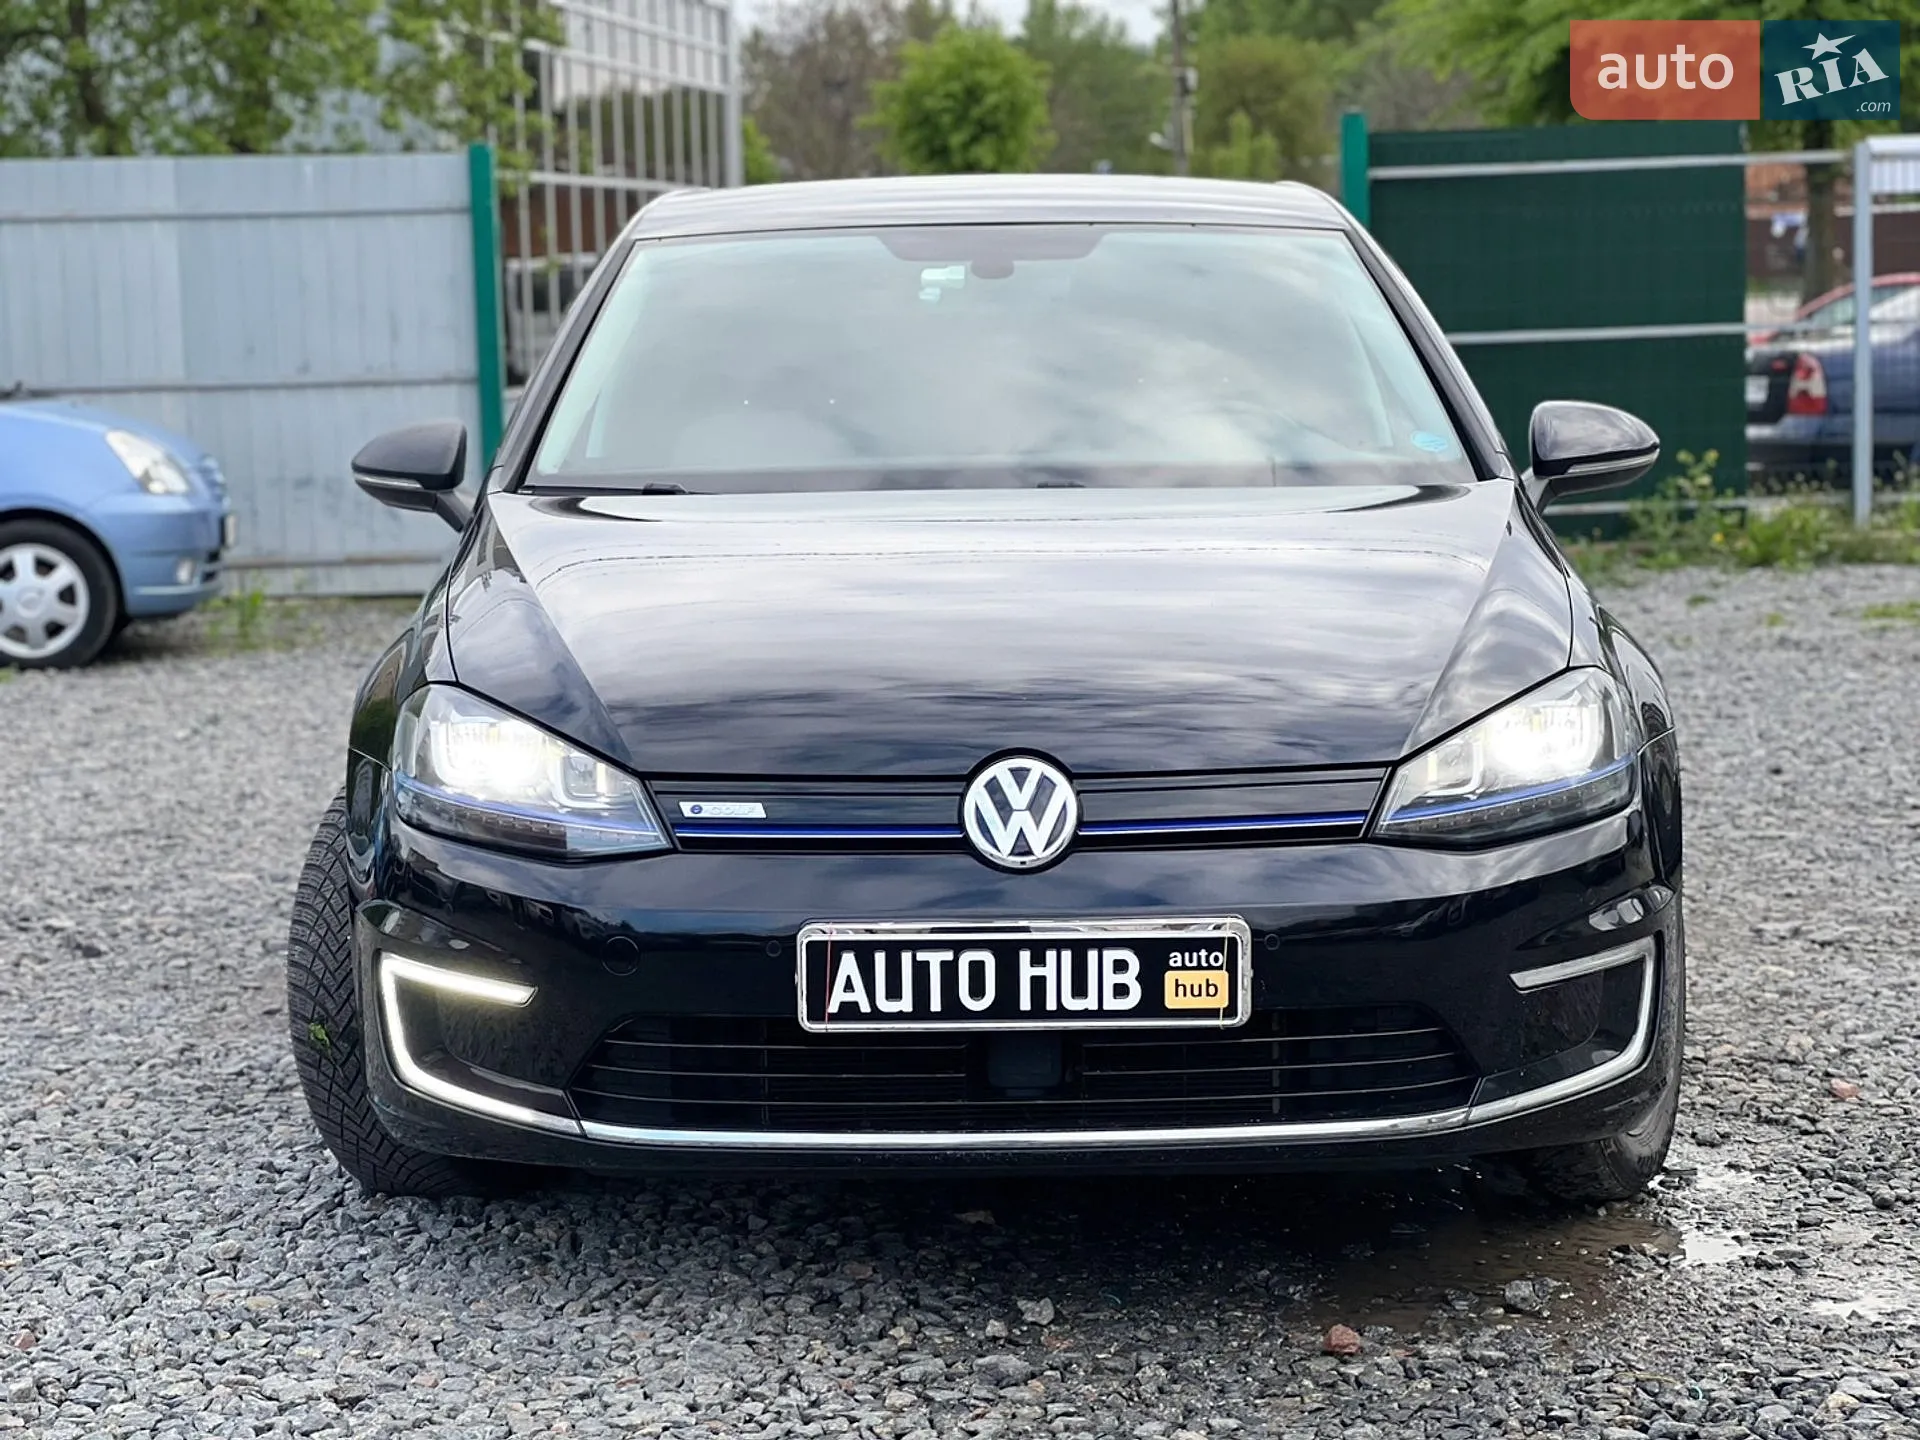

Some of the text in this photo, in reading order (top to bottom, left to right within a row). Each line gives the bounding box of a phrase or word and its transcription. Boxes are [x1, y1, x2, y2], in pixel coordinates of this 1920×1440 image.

[1168, 949, 1224, 967] auto
[827, 948, 1142, 1013] AUTO HUB
[1174, 979, 1219, 998] hub
